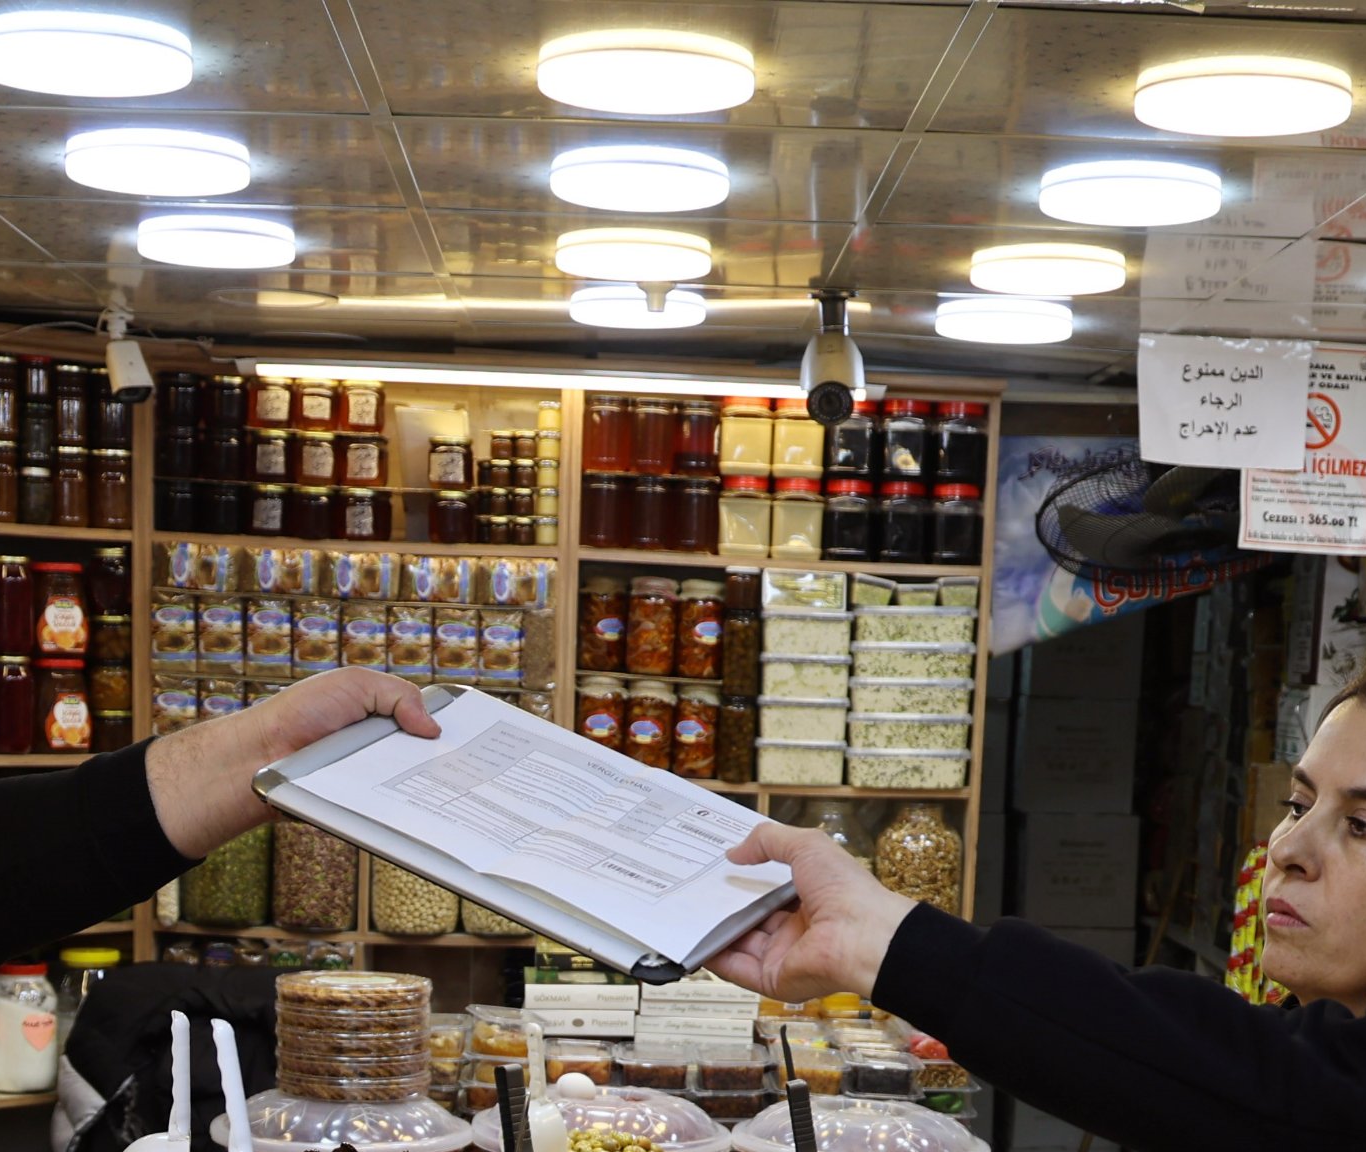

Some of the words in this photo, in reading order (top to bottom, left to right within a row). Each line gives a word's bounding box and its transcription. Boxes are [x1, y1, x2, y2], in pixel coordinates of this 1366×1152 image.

[1181, 362, 1225, 382] ممنوع
[1230, 365, 1264, 382] الدين
[1200, 393, 1243, 411] الرجاء
[1179, 420, 1229, 441] الإحراج
[1234, 423, 1258, 437] عدم
[1262, 511, 1298, 525] Cezası
[1308, 513, 1345, 527] 365.00
